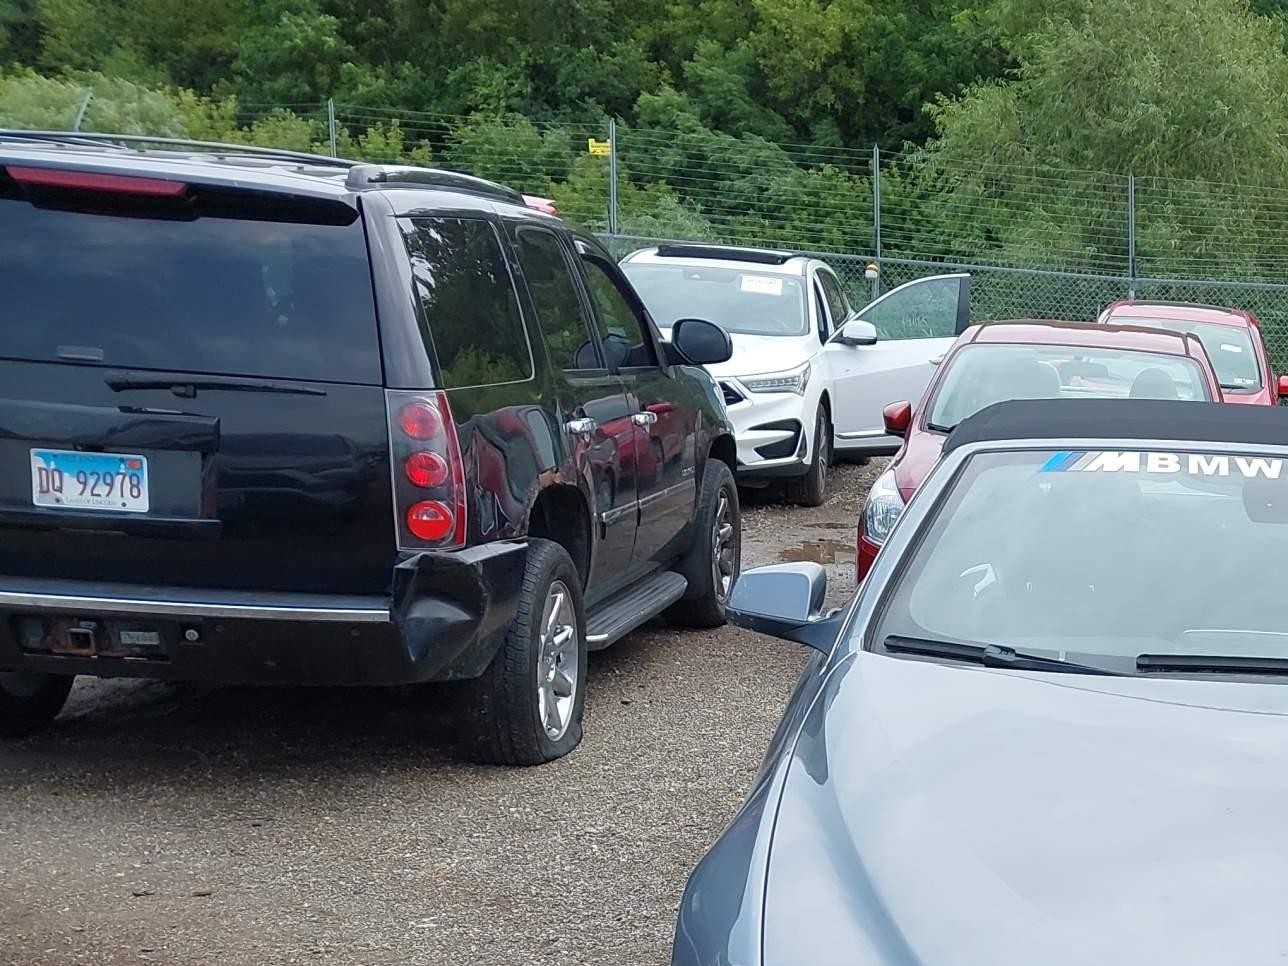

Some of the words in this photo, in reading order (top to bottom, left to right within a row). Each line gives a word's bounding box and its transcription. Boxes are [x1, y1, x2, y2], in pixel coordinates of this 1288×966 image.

[1147, 453, 1282, 478] BMW
[37, 466, 63, 494] DQ
[76, 470, 141, 499] 92978
